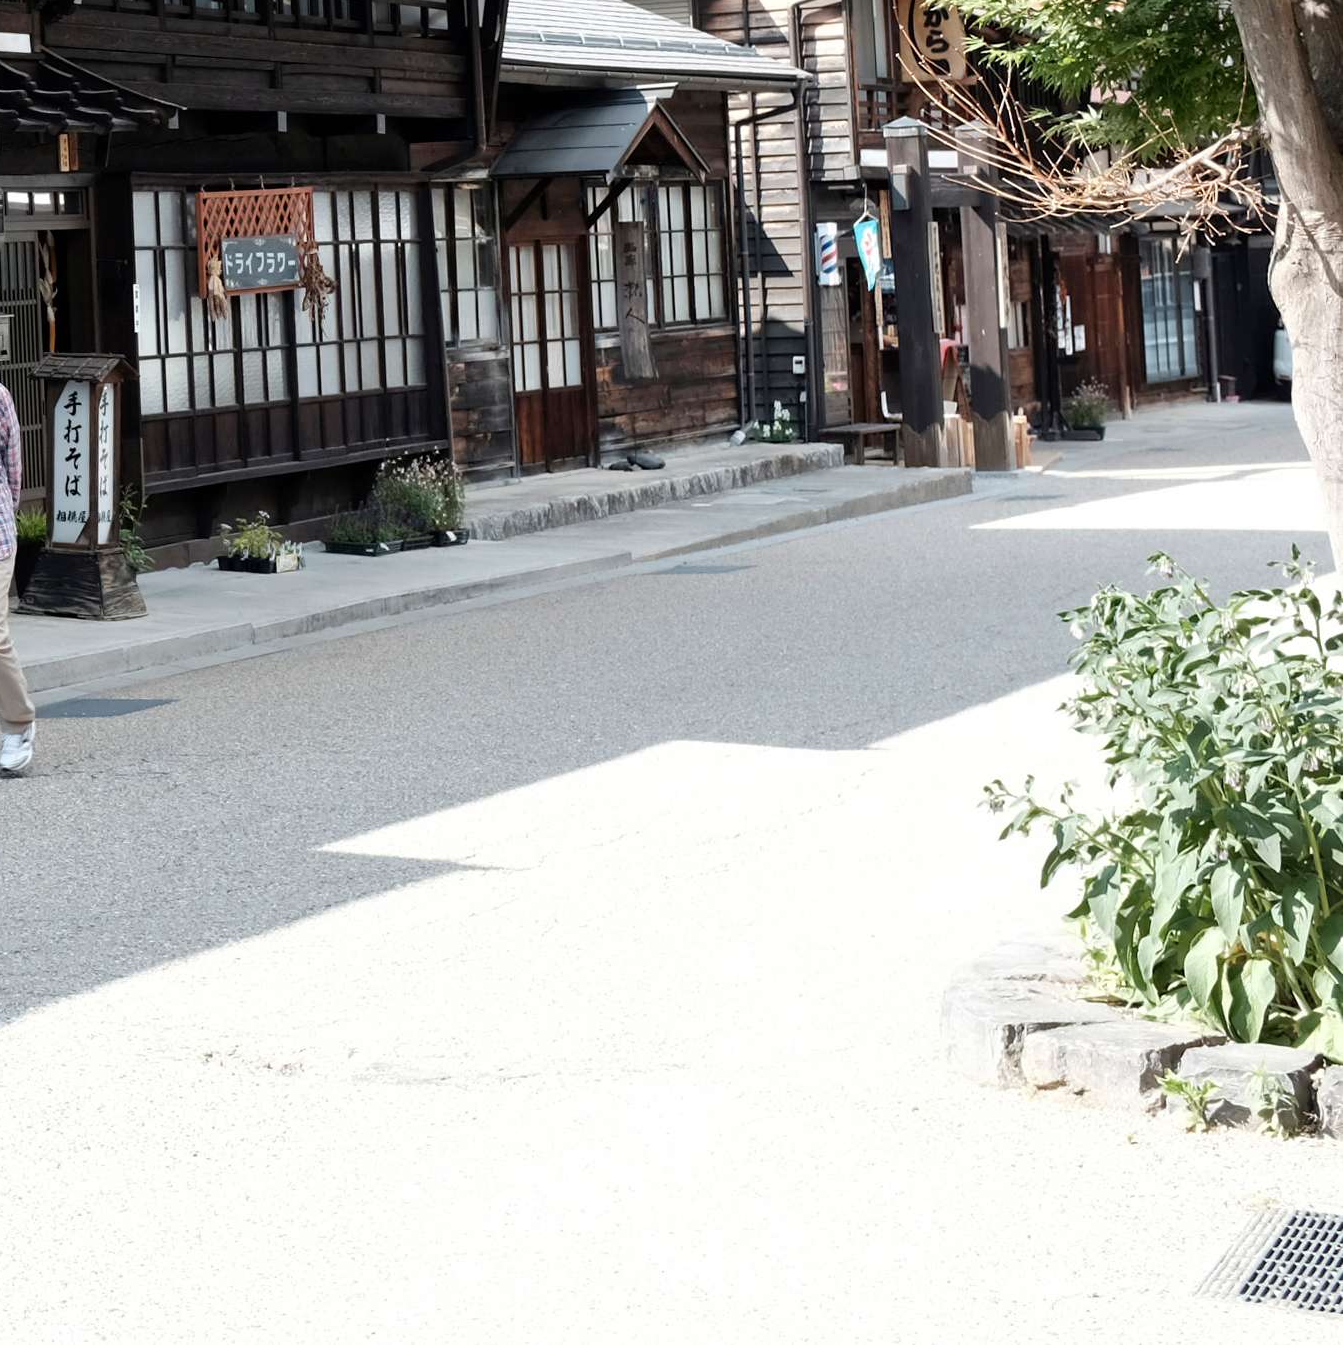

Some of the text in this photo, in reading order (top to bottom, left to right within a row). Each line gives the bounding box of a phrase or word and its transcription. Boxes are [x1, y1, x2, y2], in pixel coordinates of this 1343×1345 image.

[224, 251, 296, 275] ドライフラワー
[63, 390, 83, 498] 手打そば
